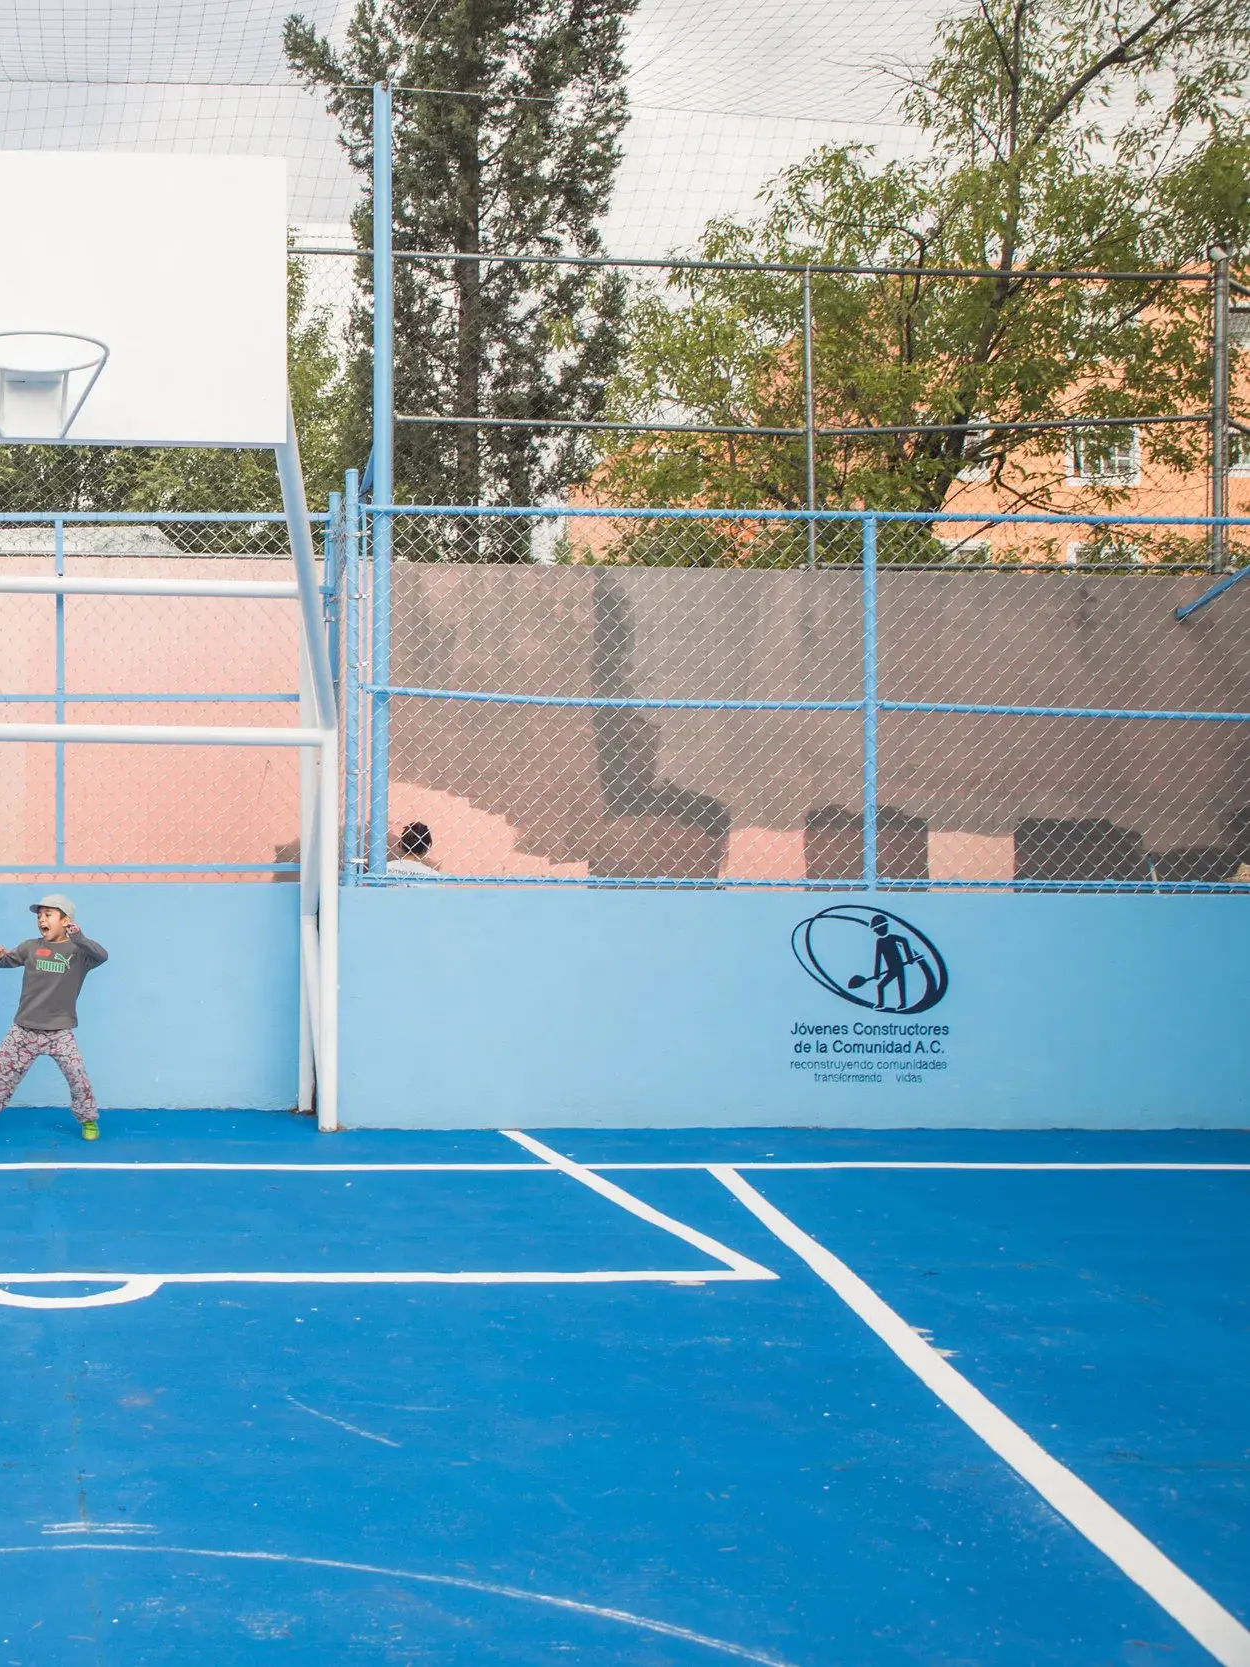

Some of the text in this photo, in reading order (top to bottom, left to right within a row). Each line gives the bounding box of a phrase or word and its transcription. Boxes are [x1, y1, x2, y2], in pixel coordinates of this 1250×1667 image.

[790, 1022, 949, 1036] Jóvenes Constructores
[794, 1040, 945, 1054] de la Comunidad A.C.
[790, 1059, 948, 1072] reconstruyendo comunidades
[814, 1072, 923, 1083] transformando vidas
